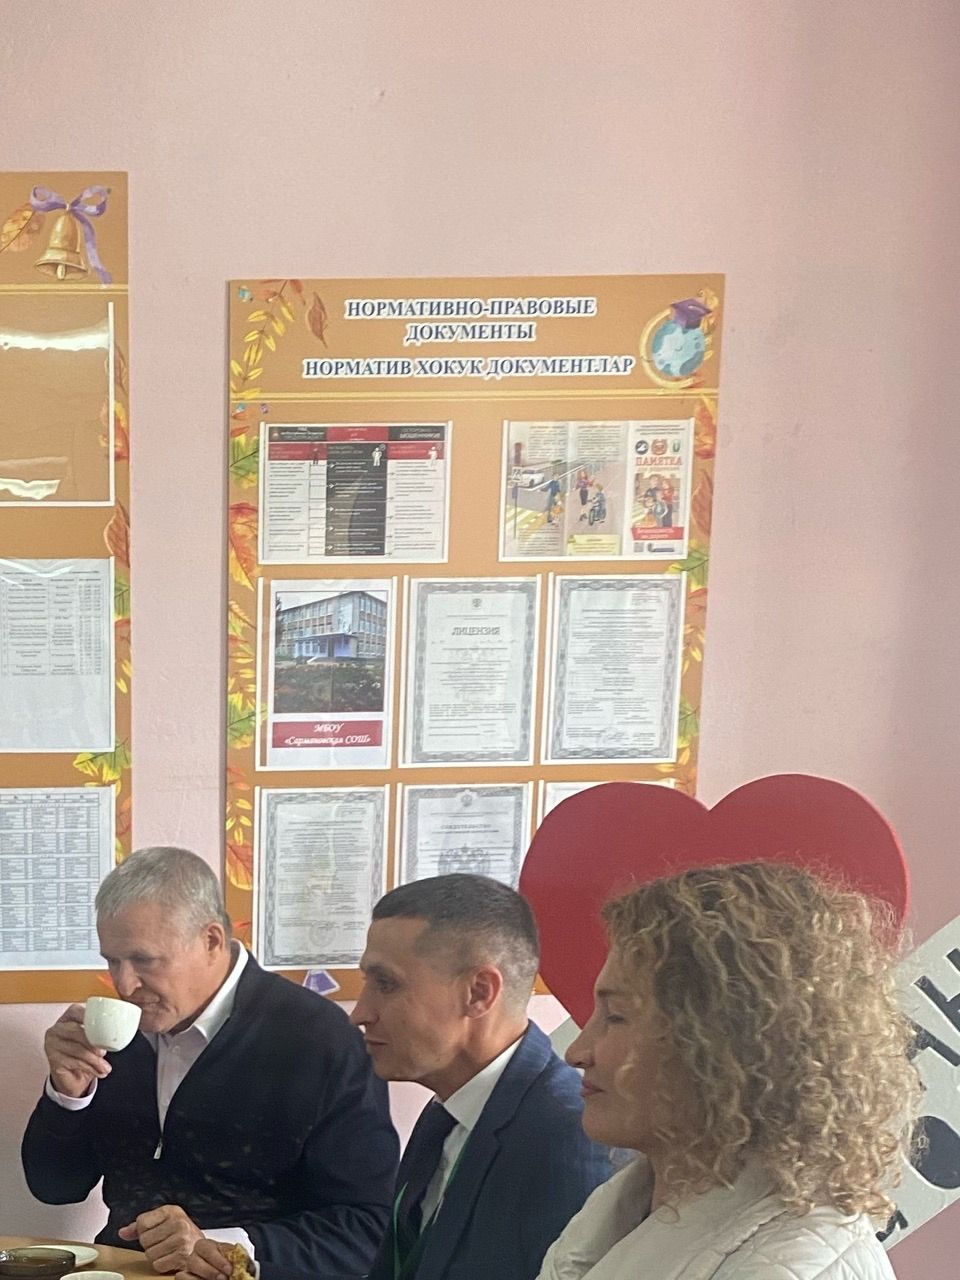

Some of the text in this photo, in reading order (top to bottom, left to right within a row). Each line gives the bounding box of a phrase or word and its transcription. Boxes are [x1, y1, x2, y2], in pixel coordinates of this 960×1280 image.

[347, 299, 595, 317] НОРМАТИВНО-ПРАВОВЫЕ
[406, 323, 534, 342] ДОКУМЕНТЫ
[304, 358, 634, 377] НОРМАТИВ ХОКУК ДОКУМЕНТЛАР
[636, 456, 682, 466] ПАМЯТКА
[451, 626, 501, 636] ЛИЦЕНЗИЯ
[313, 722, 344, 733] МБОУ
